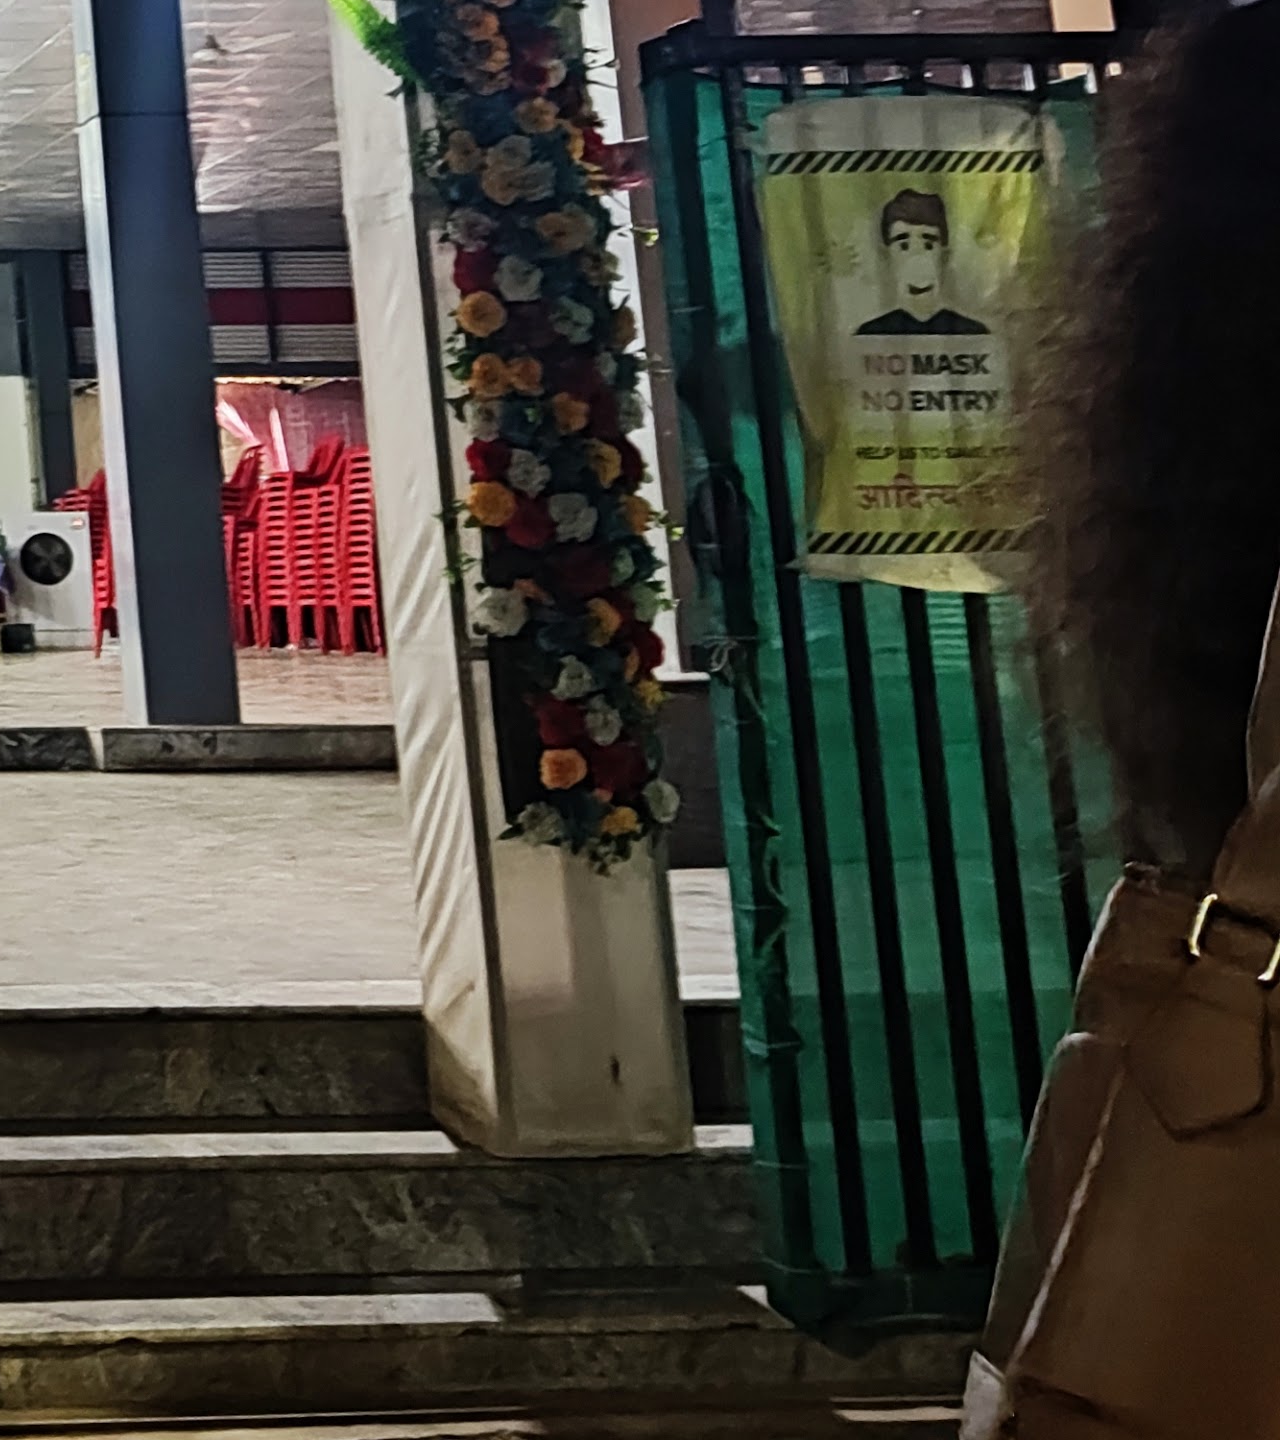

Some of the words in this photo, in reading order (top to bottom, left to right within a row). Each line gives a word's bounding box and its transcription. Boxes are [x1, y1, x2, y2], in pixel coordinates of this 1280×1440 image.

[863, 353, 906, 376] NO
[910, 353, 991, 376] MASK
[861, 390, 904, 412] NO
[908, 389, 1000, 413] ENTRY
